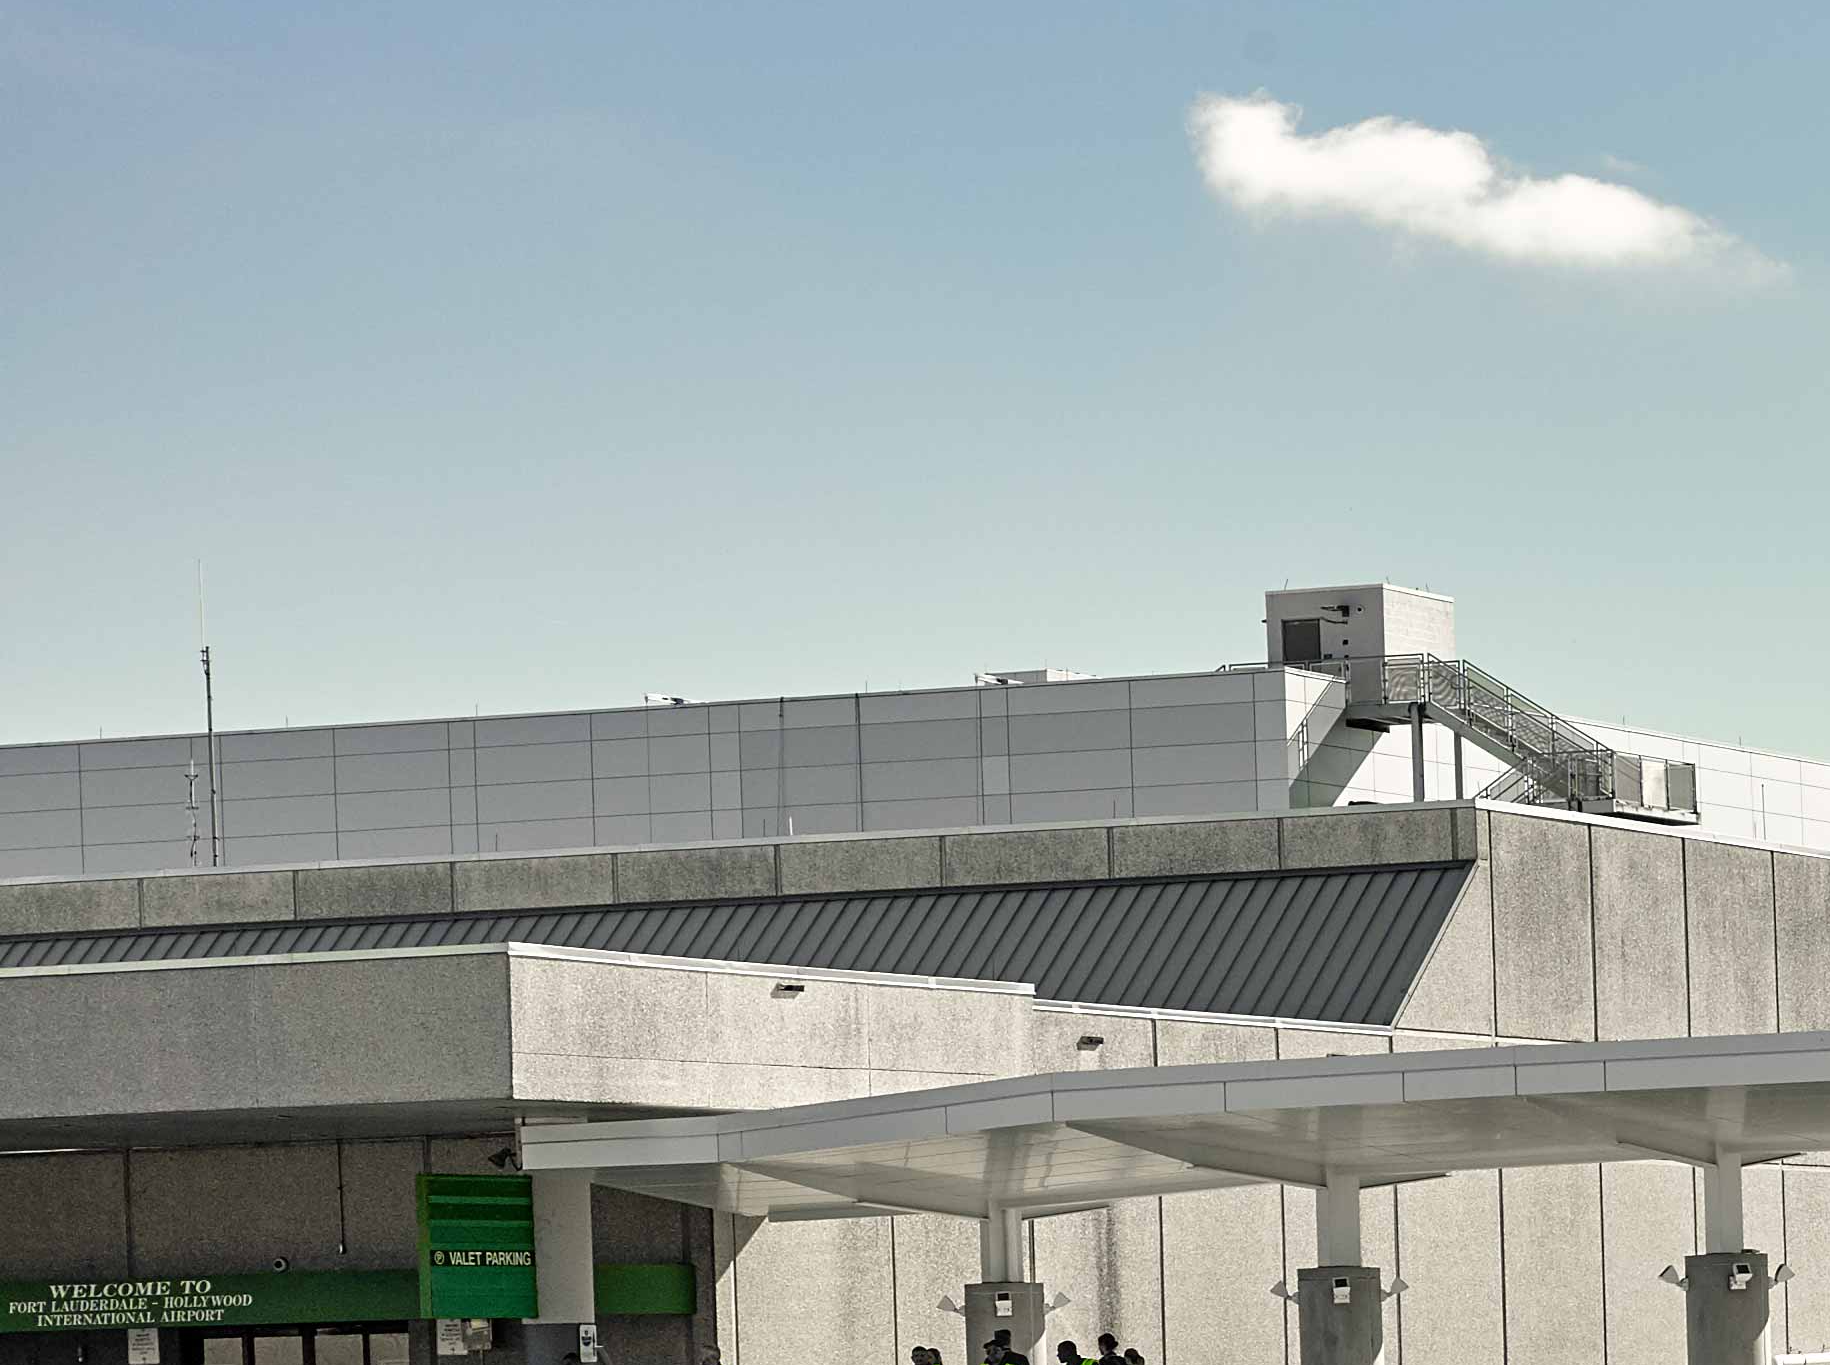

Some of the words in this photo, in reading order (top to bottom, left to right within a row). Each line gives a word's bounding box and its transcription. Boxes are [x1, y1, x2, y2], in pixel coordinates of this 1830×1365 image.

[449, 1251, 482, 1265] VALET
[486, 1251, 532, 1266] PARKING
[50, 1281, 171, 1299] WELCOME
[180, 1279, 212, 1295] TO
[9, 1301, 47, 1314] FORT
[51, 1297, 148, 1313] LAUDERDALE
[164, 1294, 253, 1309] HOLLYWOOD
[37, 1312, 155, 1327] INTERNATIONAL
[161, 1309, 225, 1323] AIRPORT
